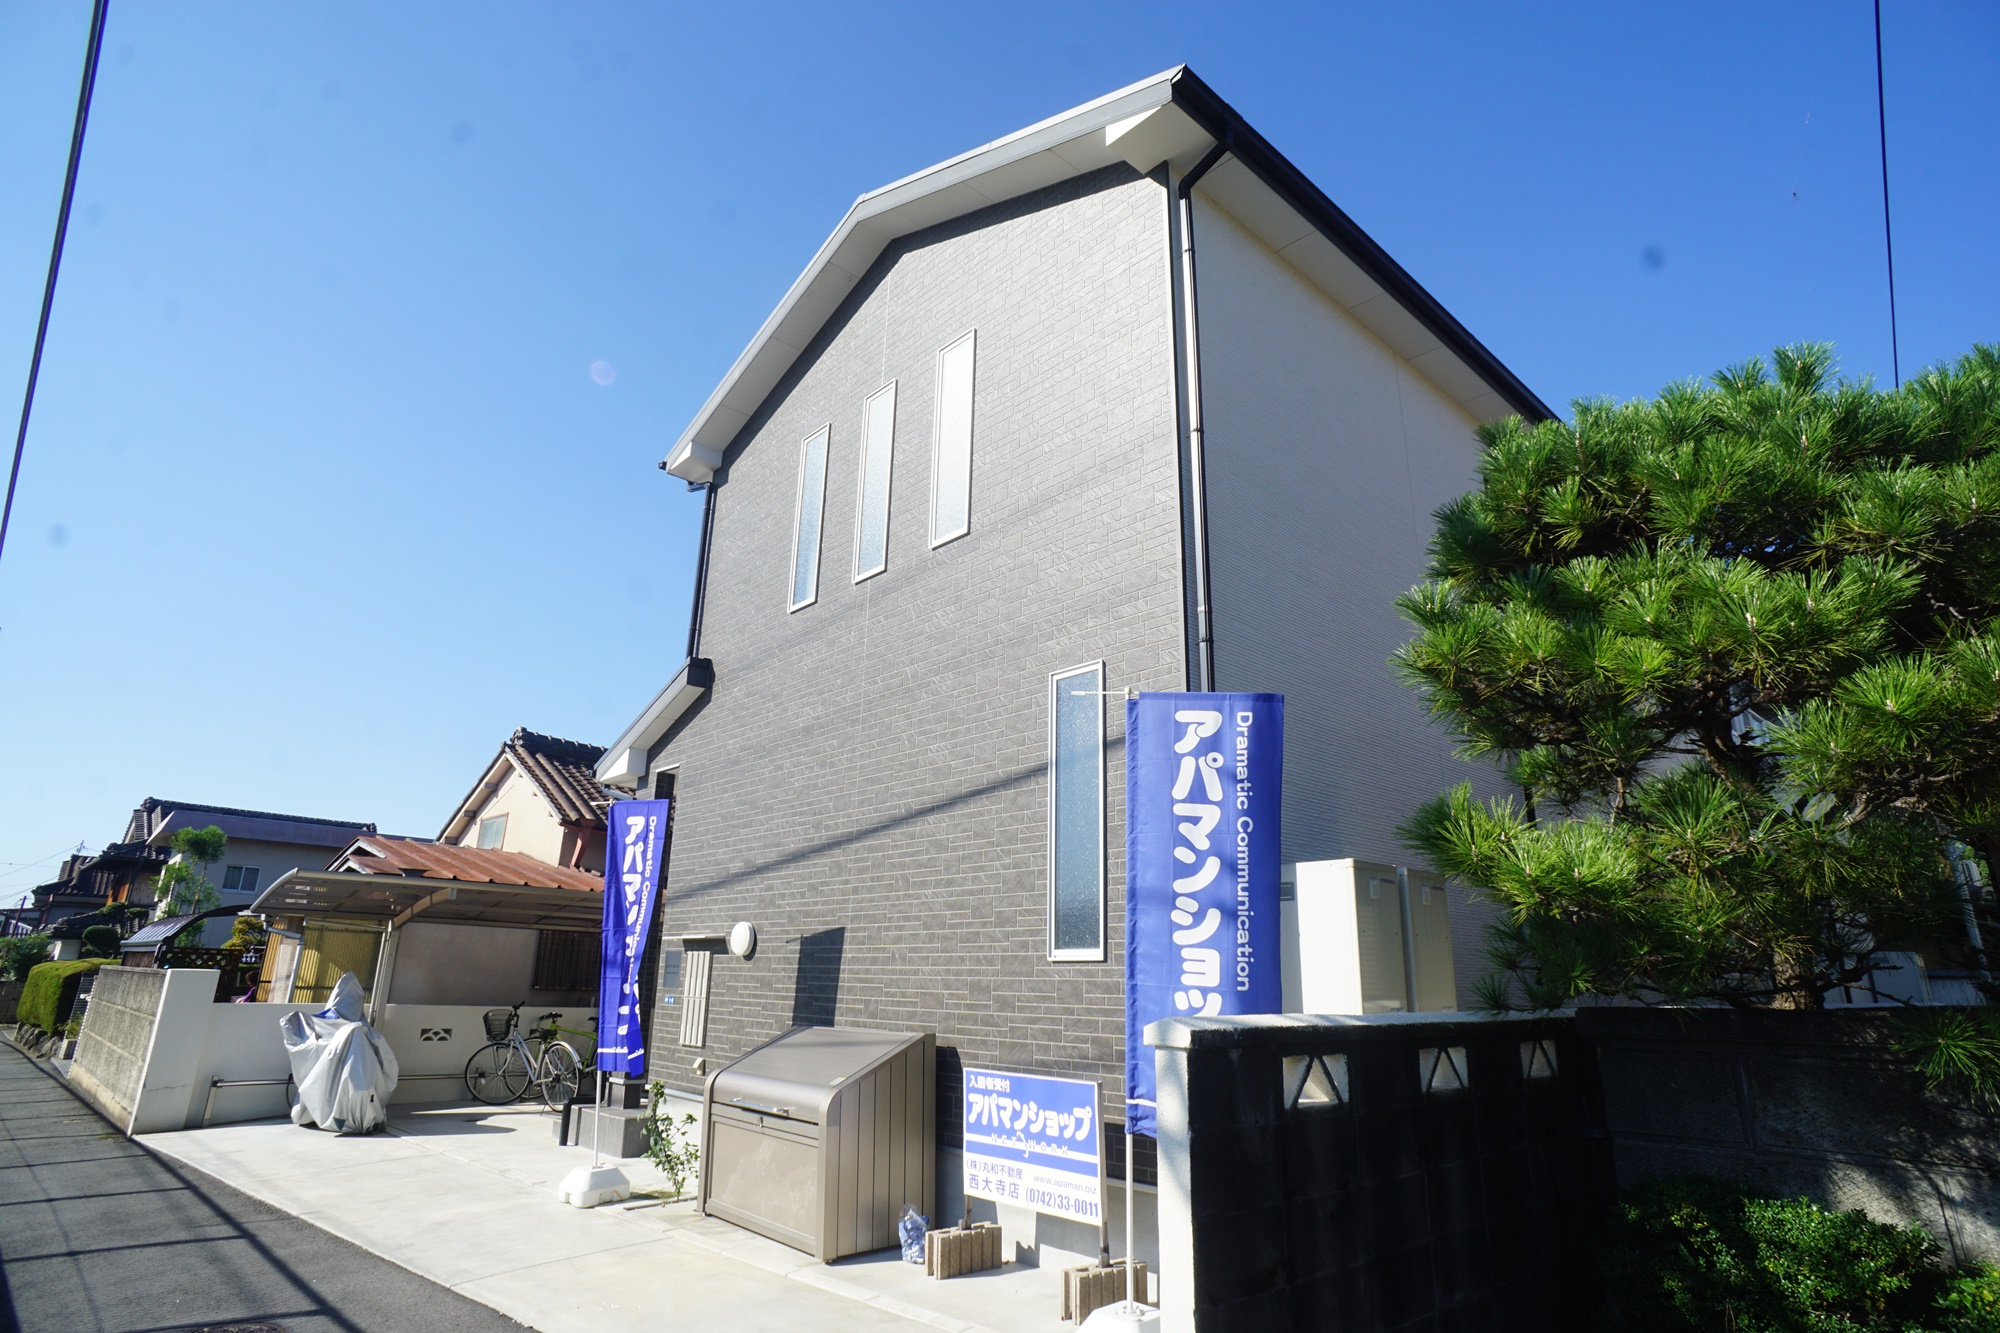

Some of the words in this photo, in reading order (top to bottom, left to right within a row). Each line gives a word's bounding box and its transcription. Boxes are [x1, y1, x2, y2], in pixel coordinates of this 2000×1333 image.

[1236, 711, 1253, 810] Dramatic
[644, 816, 657, 878] Dramatic
[1236, 816, 1254, 991] Communication
[968, 1093, 1092, 1141] アパマンショップ
[966, 1158, 1023, 1180] (株)丸和不動産
[1033, 1174, 1097, 1195] www.apaman.biz
[969, 1173, 1020, 1199] 西大寺店
[1025, 1187, 1099, 1217] (0742)33-0011
